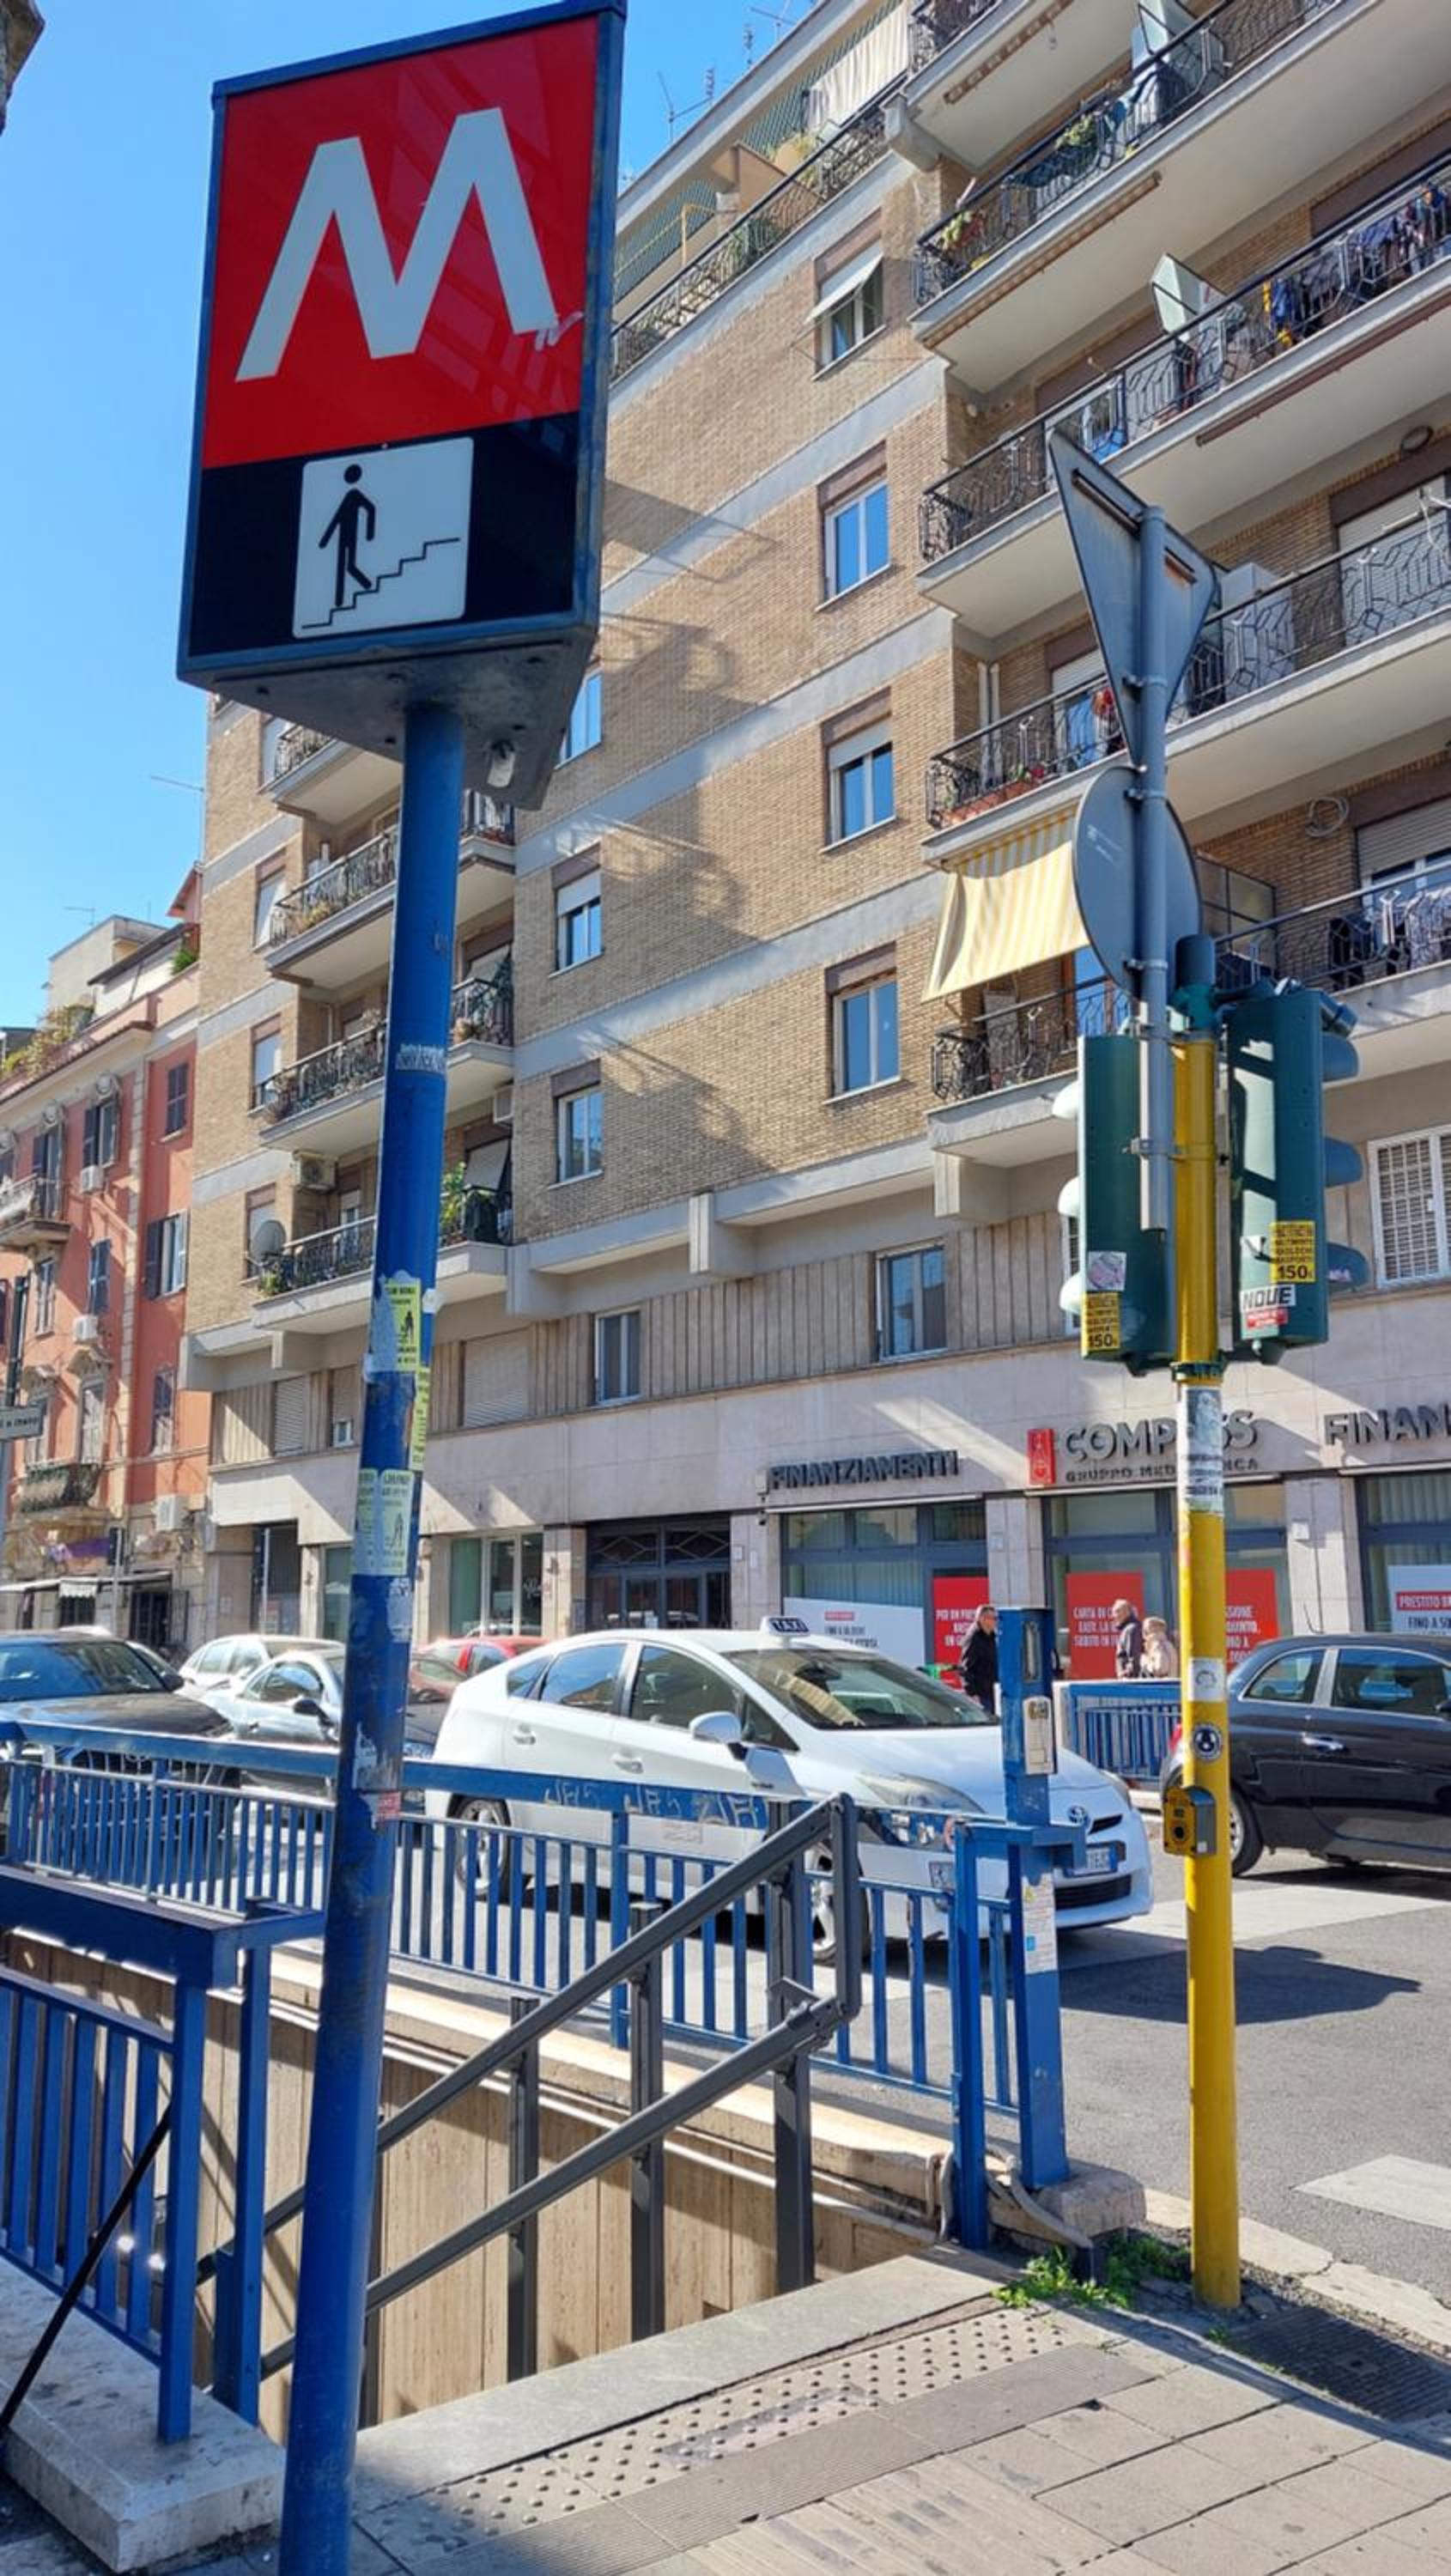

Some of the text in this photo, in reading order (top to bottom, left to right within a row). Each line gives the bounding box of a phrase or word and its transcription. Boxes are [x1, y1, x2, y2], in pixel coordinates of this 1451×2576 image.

[236, 107, 557, 382] M
[769, 1449, 959, 1490] FINANZIAMENTI
[1065, 1468, 1133, 1483] GRUPPO
[772, 1619, 808, 1631] TAXI
